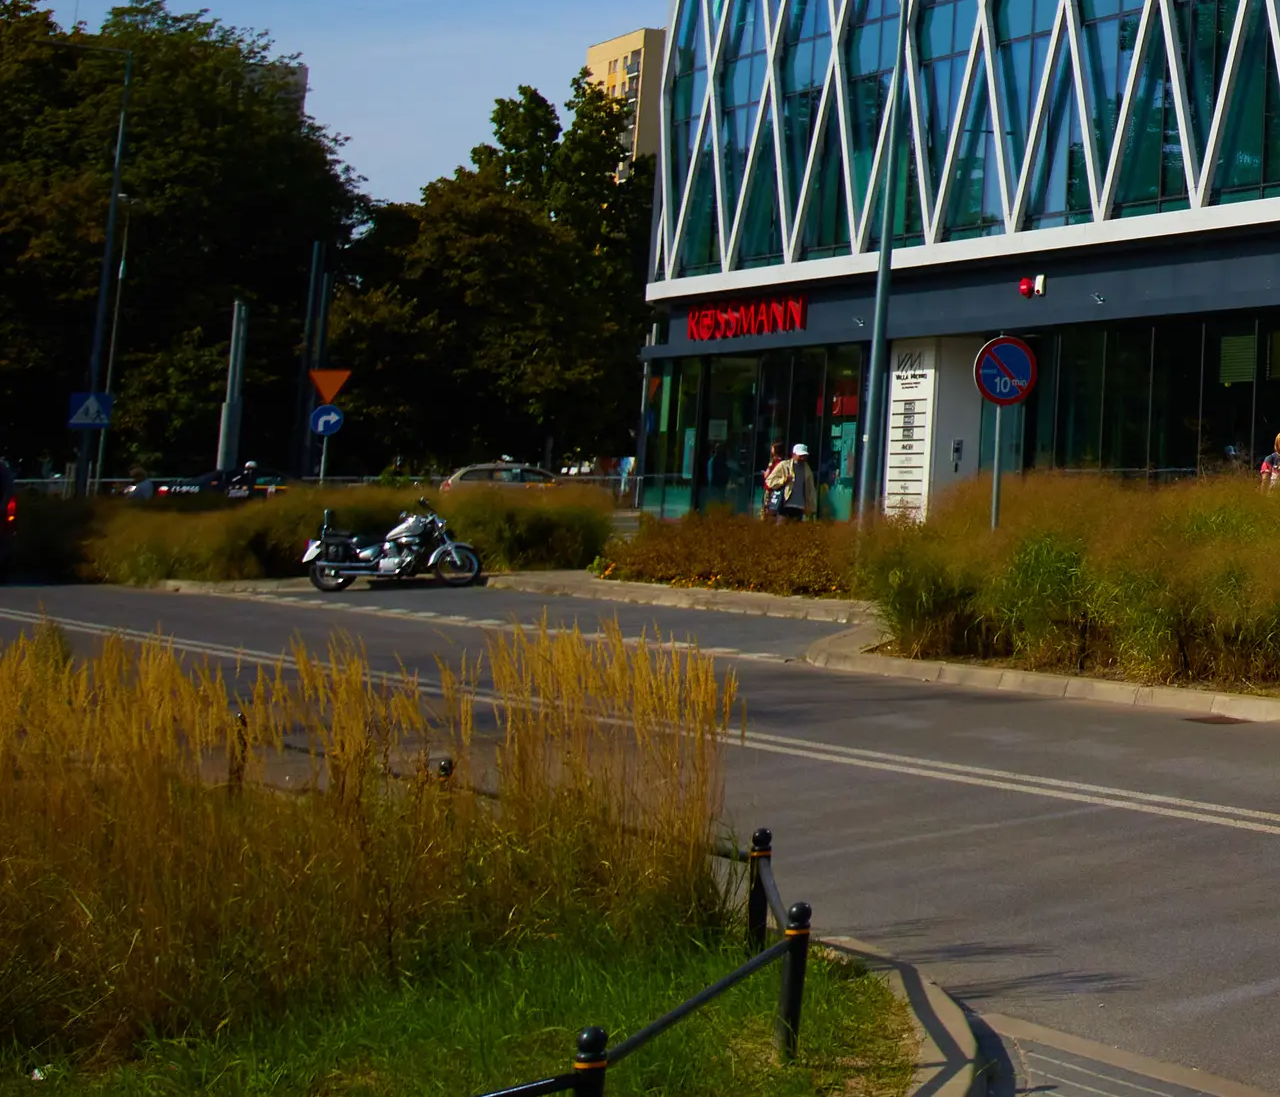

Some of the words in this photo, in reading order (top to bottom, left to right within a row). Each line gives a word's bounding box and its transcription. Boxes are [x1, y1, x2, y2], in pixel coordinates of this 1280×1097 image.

[687, 299, 805, 340] ROSSMANN
[994, 377, 1010, 393] 10
[1012, 377, 1027, 387] min
